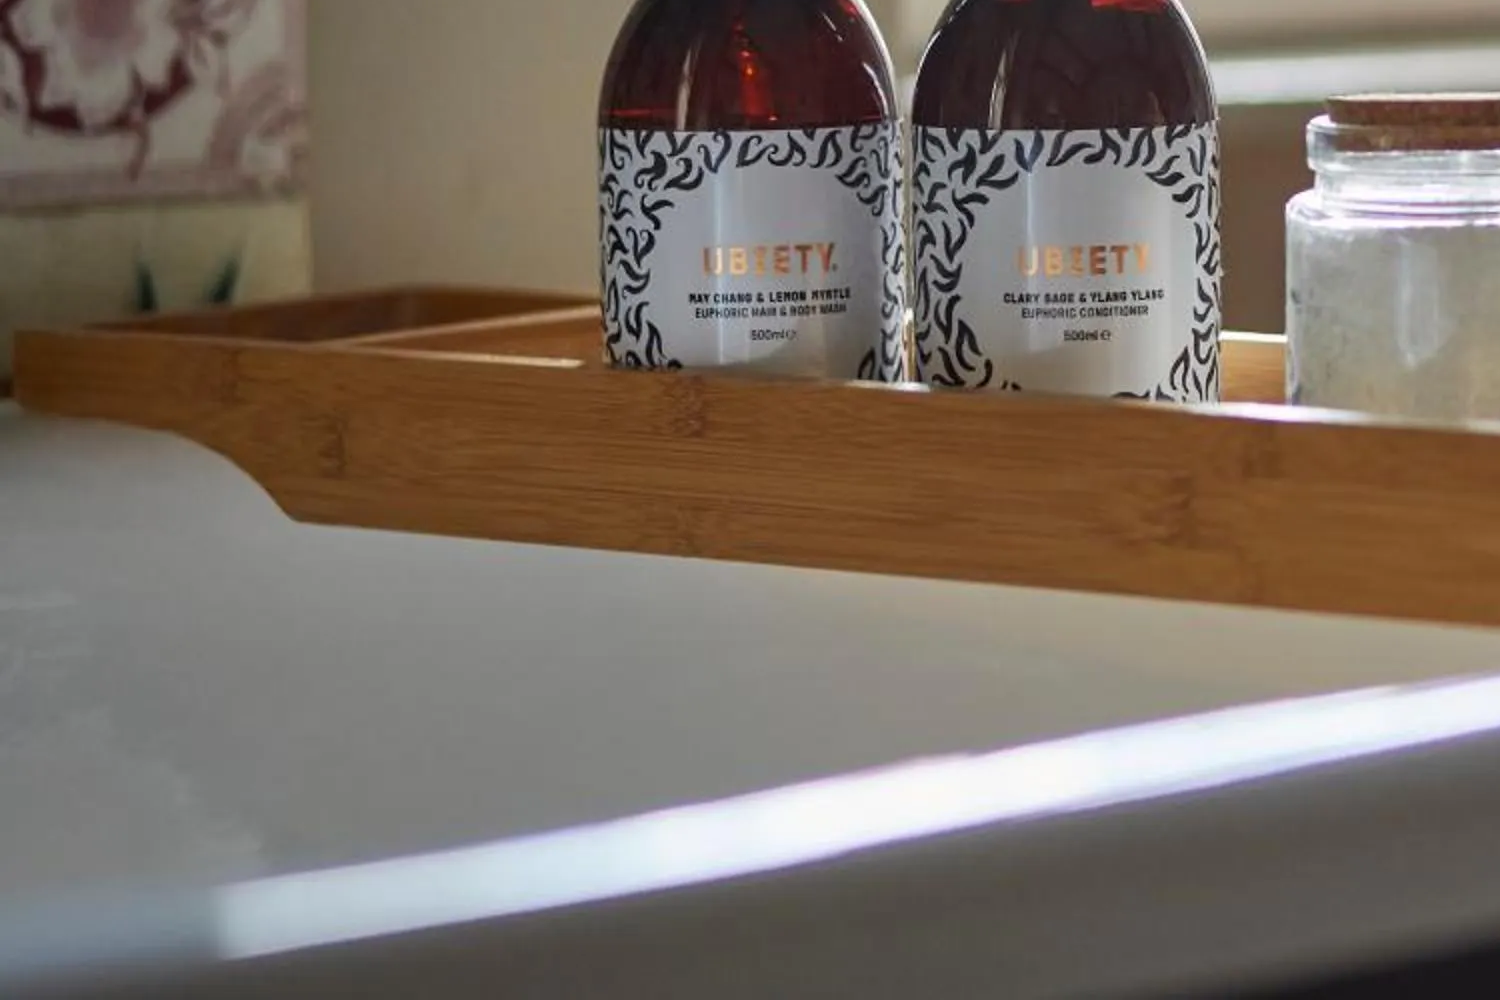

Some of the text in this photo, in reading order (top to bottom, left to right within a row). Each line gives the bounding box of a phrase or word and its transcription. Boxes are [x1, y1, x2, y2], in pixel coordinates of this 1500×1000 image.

[689, 286, 851, 304] MAY CHANG & LEMON MYRTLE
[1003, 292, 1040, 304] CLARY
[1079, 292, 1087, 303] &
[1090, 291, 1127, 302] YLANG
[1131, 288, 1164, 301] YLANG
[695, 307, 748, 319] EUPHORIC
[1022, 307, 1077, 319] EUPHORIC
